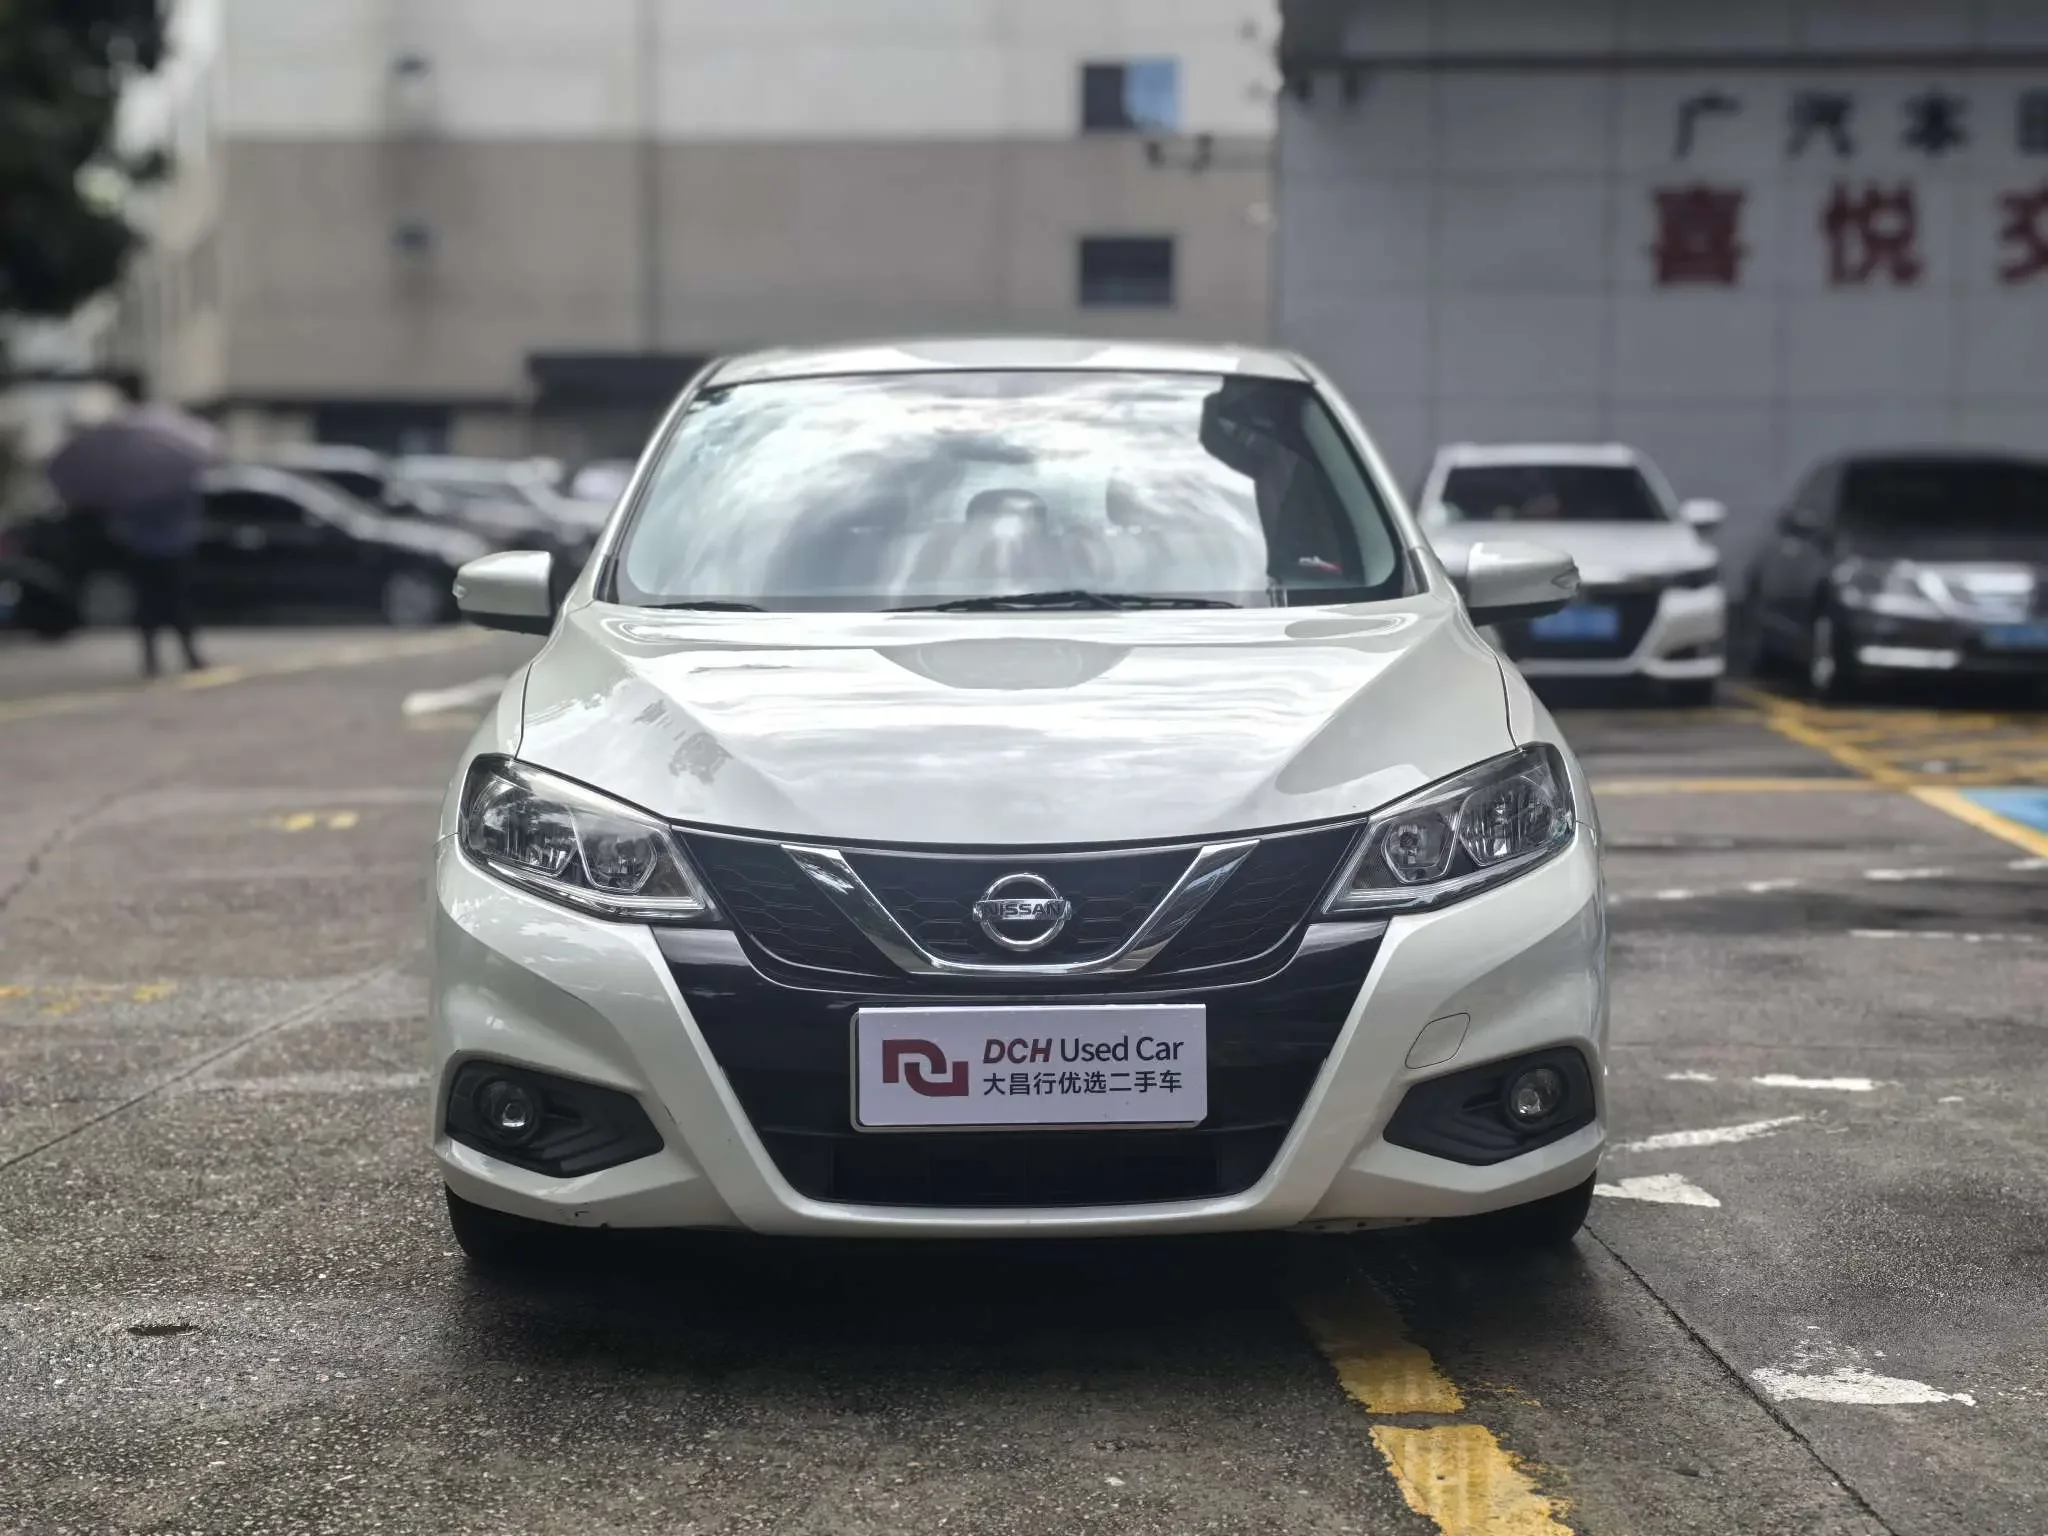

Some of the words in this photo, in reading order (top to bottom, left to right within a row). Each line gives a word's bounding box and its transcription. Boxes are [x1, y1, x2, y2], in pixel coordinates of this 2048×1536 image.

[982, 903, 1061, 917] NISSAN
[982, 1038, 1053, 1064] DCH
[1060, 1035, 1129, 1063] Used
[1136, 1036, 1184, 1062] Car
[982, 1069, 1183, 1096] 大昌行优选二手车
